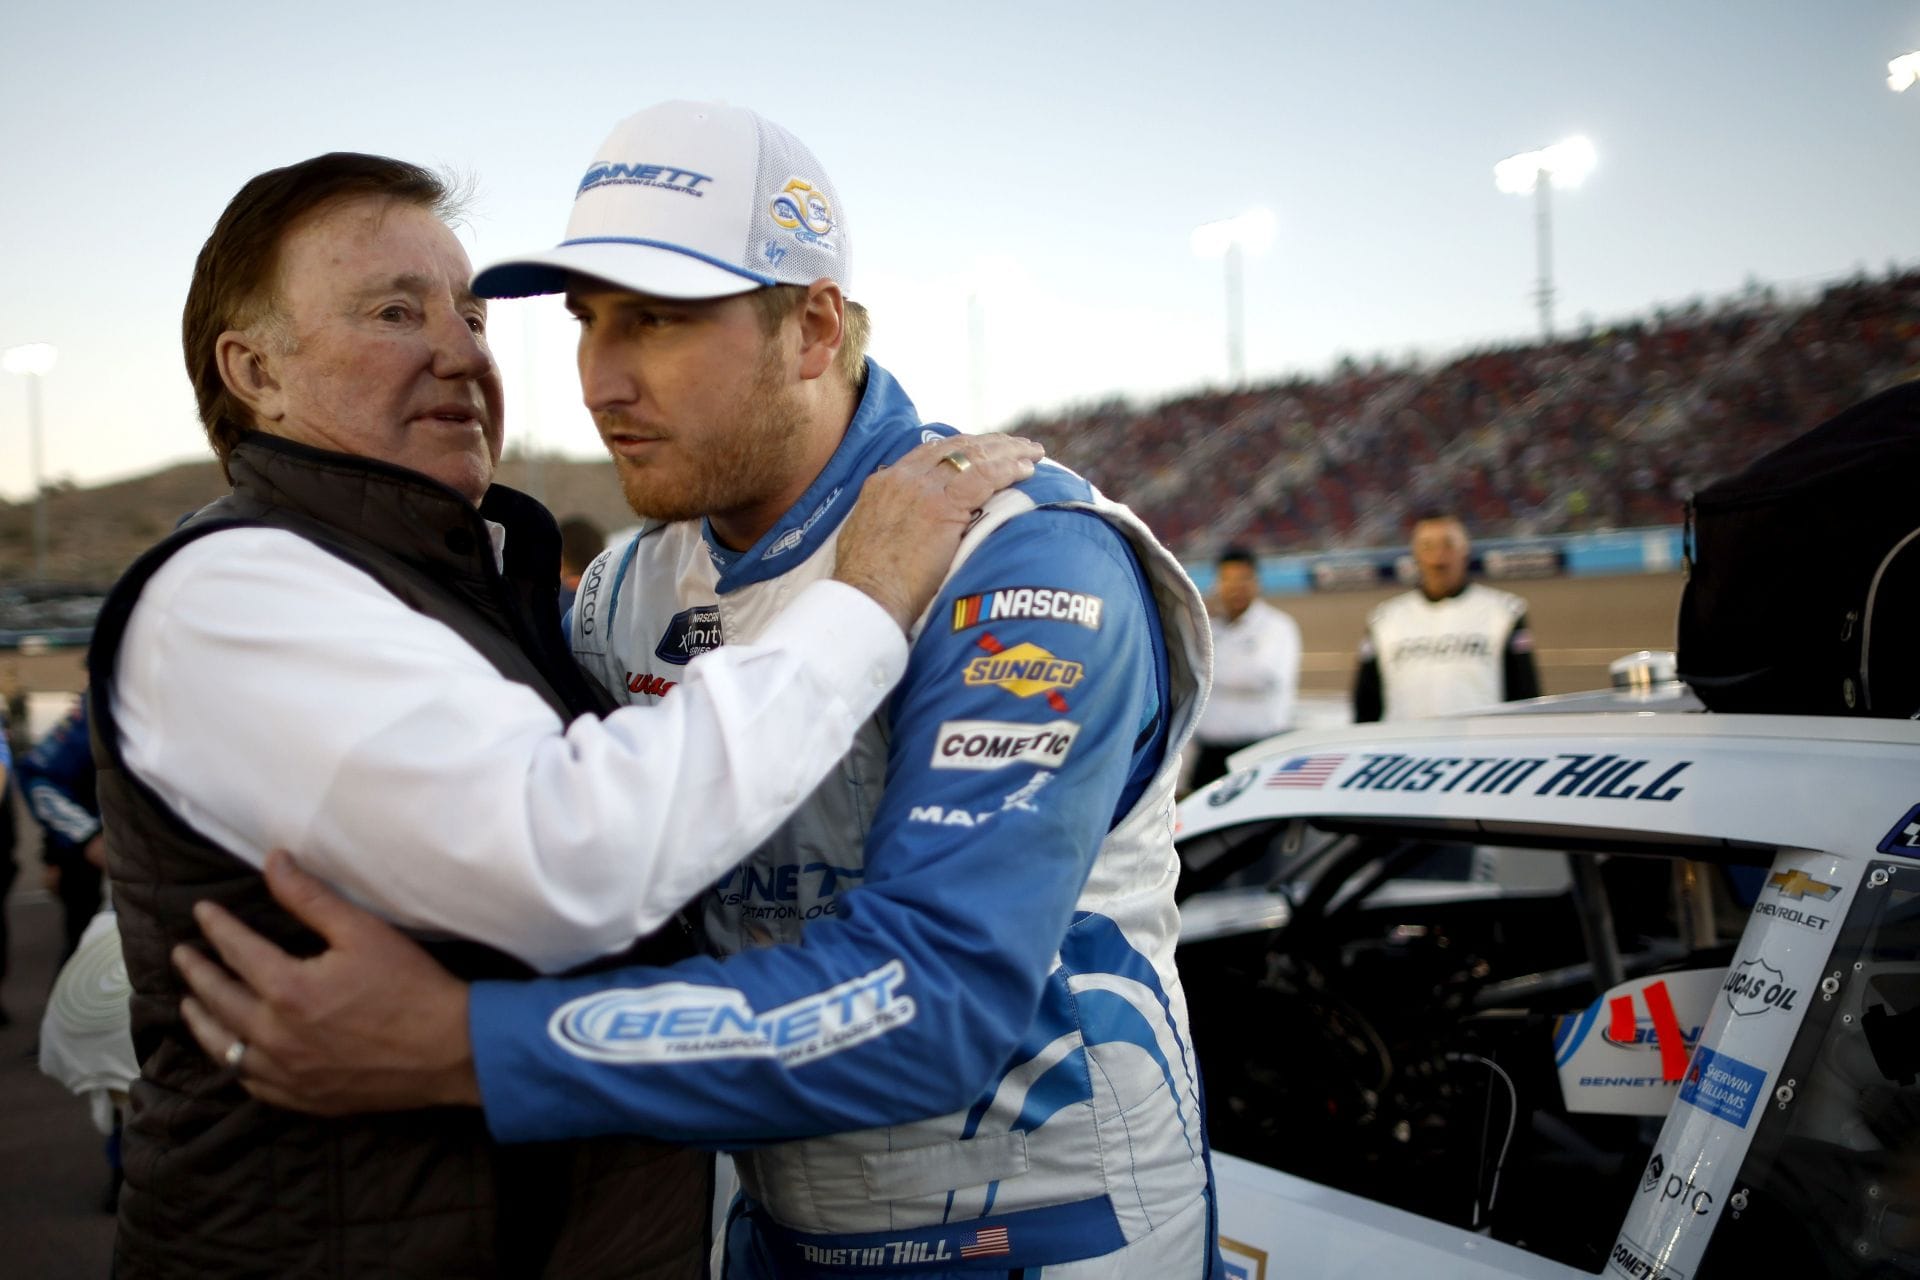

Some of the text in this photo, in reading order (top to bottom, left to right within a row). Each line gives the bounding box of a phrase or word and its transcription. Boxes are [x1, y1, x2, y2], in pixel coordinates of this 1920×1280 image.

[579, 163, 714, 190] ENNETT
[583, 551, 612, 635] sparco
[990, 588, 1102, 627] NASCAR
[968, 659, 1078, 685] SUNOCO
[941, 731, 1070, 758] COMETIC
[1340, 753, 1694, 801] AUSTIN HILL
[1755, 902, 1830, 930] CHEVROLET
[1723, 971, 1798, 1011] LUCAS OIL
[1698, 1078, 1746, 1109] WILLIAMS
[1705, 1063, 1752, 1094] SHERWIN
[1659, 1173, 1713, 1216] ptc
[796, 1239, 952, 1266] AUSTIN HILL
[1612, 1243, 1672, 1280] COMET
